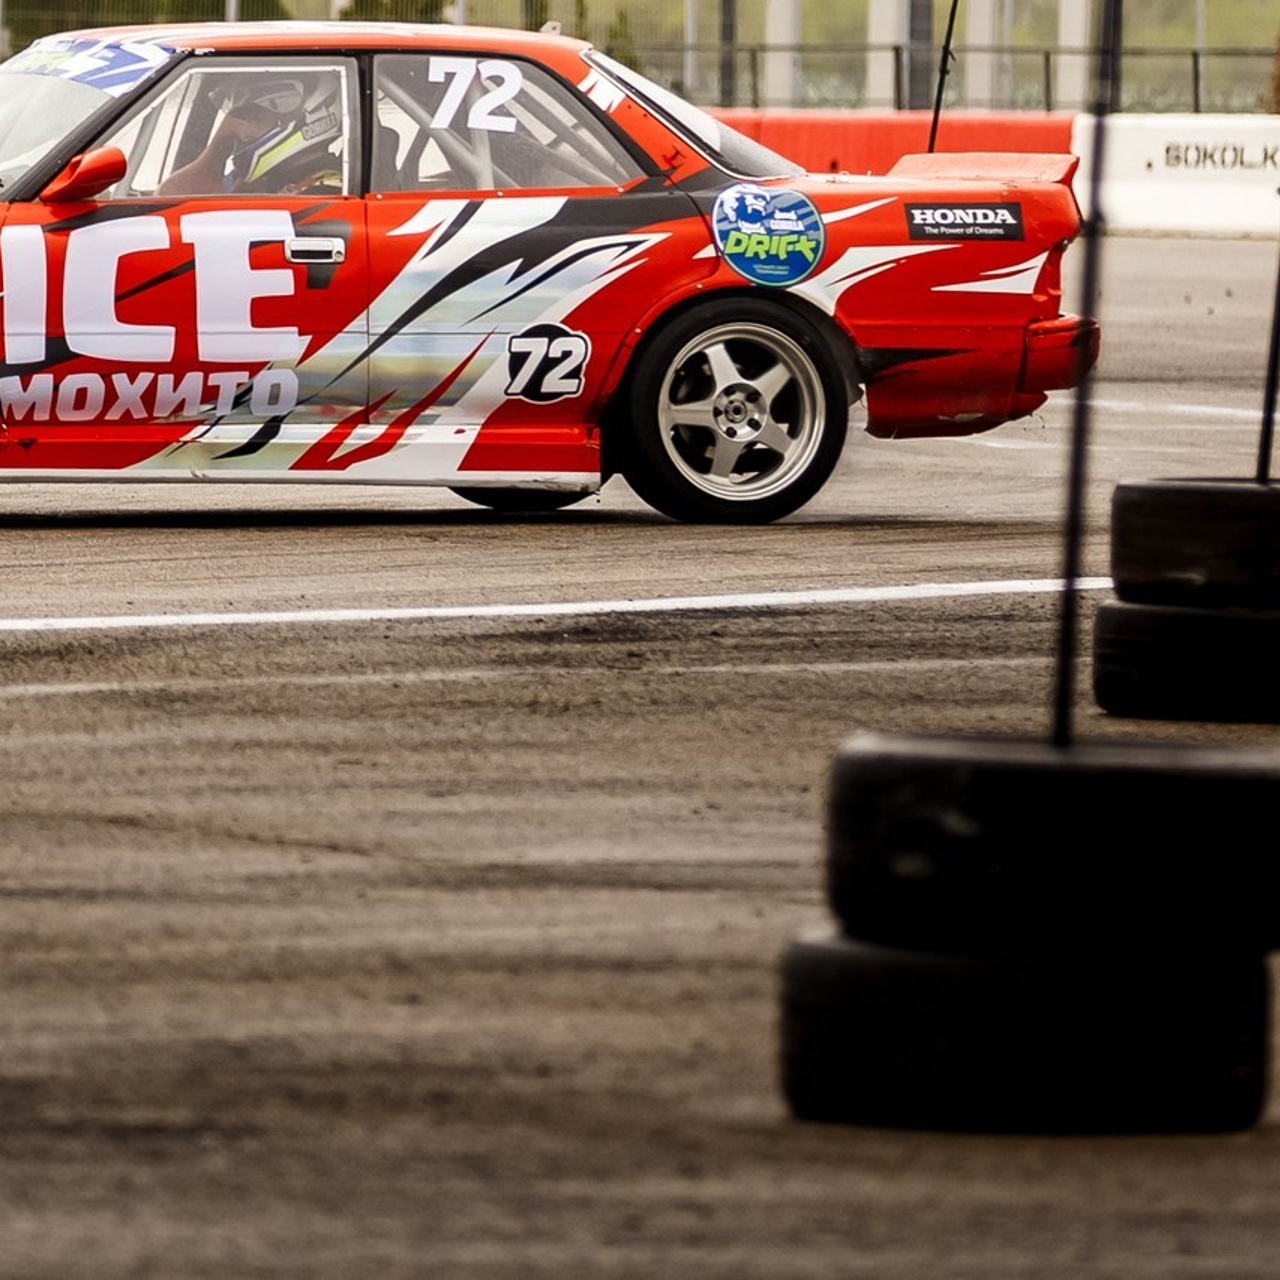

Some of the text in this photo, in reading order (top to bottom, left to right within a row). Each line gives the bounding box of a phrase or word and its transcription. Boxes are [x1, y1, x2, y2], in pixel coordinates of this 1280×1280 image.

[428, 57, 522, 133] 72
[911, 209, 1017, 224] HONDA
[924, 226, 1005, 235] The Power of Dreams
[724, 231, 816, 263] DRIFT
[0, 210, 300, 365] ICE
[506, 336, 588, 396] 72
